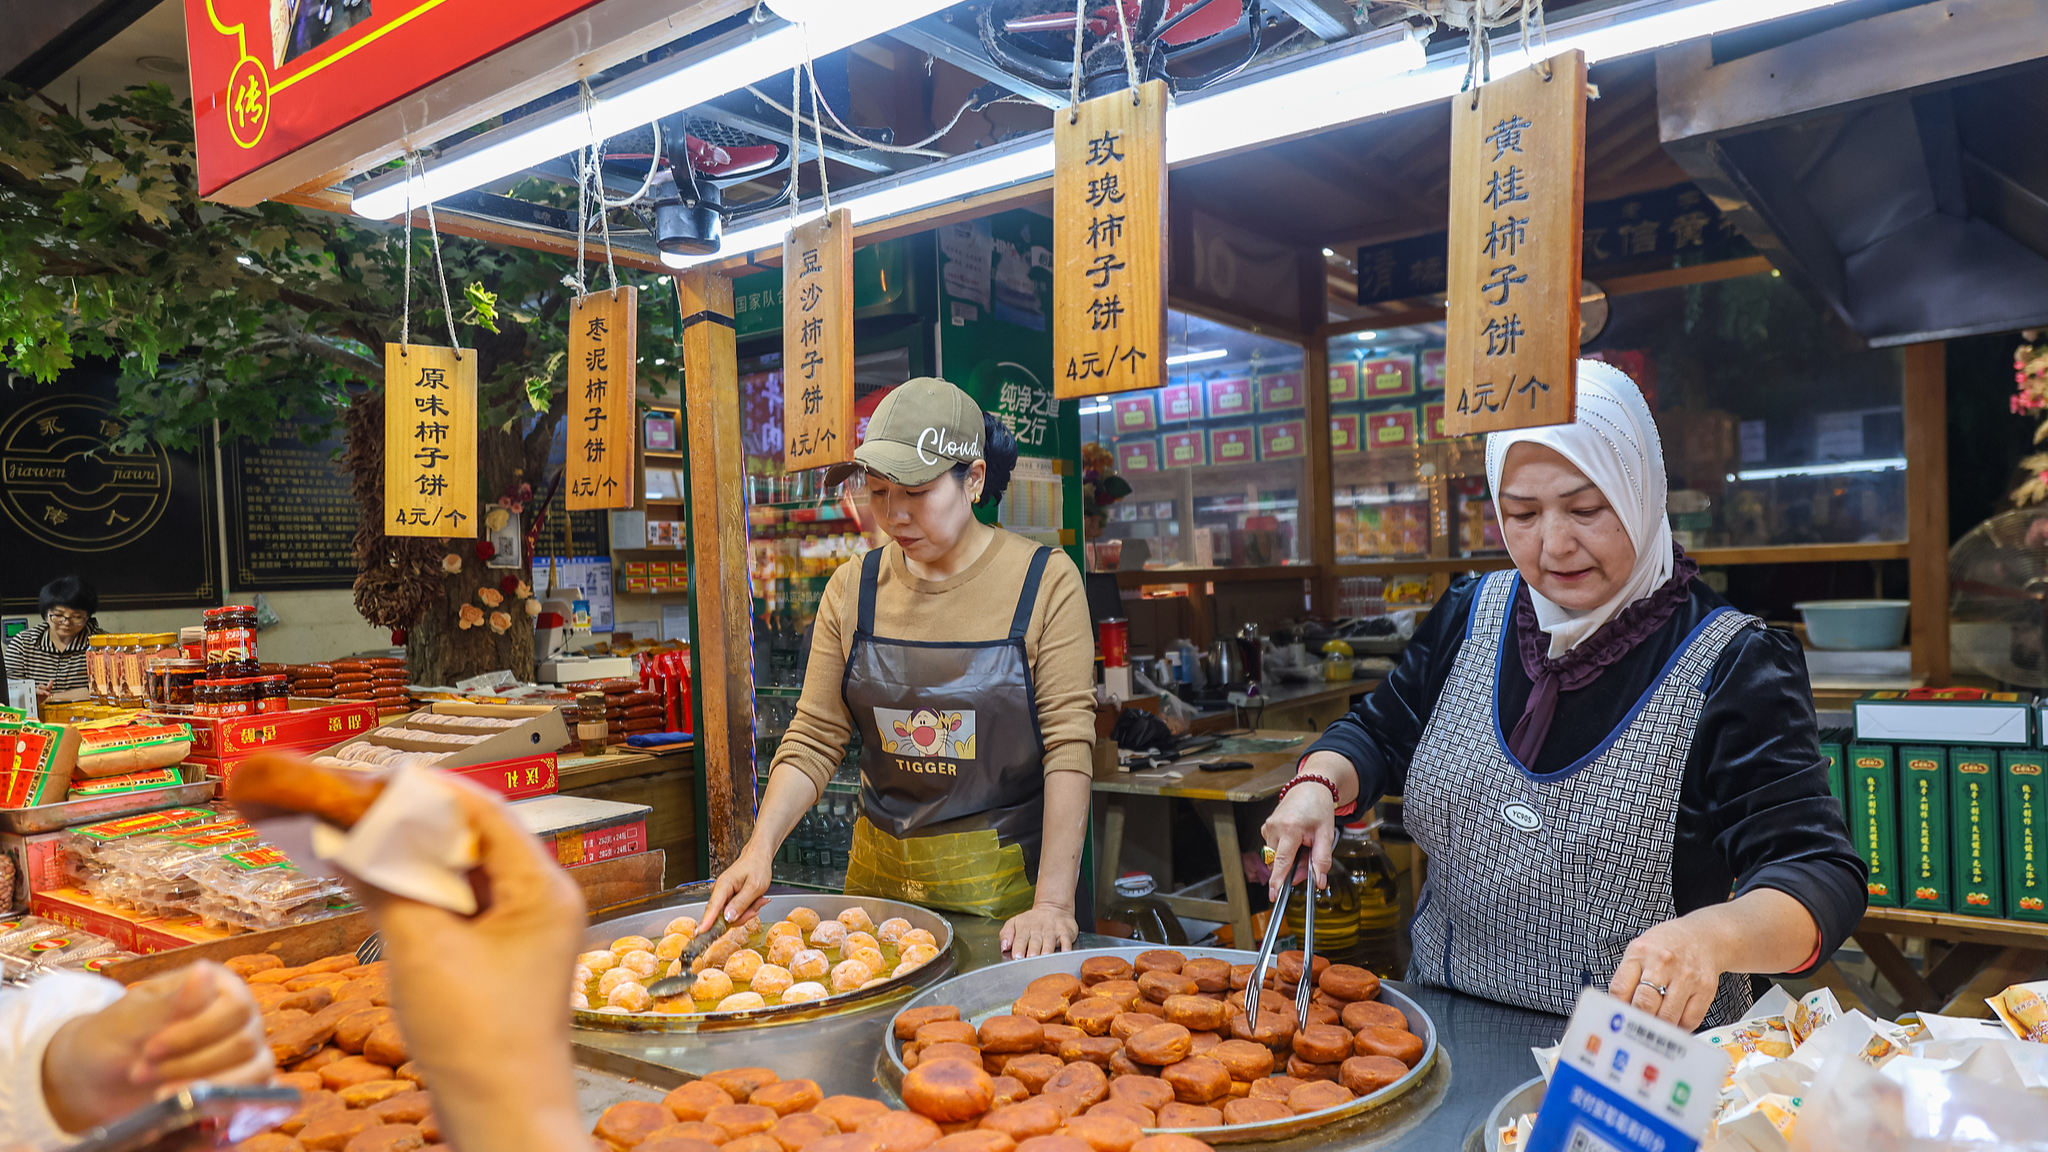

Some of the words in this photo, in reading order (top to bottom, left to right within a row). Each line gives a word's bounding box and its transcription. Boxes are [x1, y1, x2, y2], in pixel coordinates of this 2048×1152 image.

[234, 75, 263, 128] 传
[1085, 130, 1126, 331] 玫瑰柿子饼
[1481, 114, 1533, 357] 黄桂柿子饼
[800, 248, 823, 417] 豆沙柿子饼
[1066, 345, 1147, 381] 4元/个
[584, 316, 608, 464] 枣泥柿子饼
[998, 381, 1060, 418] 纯净之道
[1456, 374, 1550, 416] 4元/个
[414, 367, 449, 497] 原味柿子饼
[790, 428, 836, 458] 4元/个
[985, 410, 1047, 446] 善之行
[572, 475, 618, 498] 4元/个
[396, 506, 467, 528] 4元/个
[504, 766, 540, 789] 送礼
[895, 758, 957, 776] TIGGER
